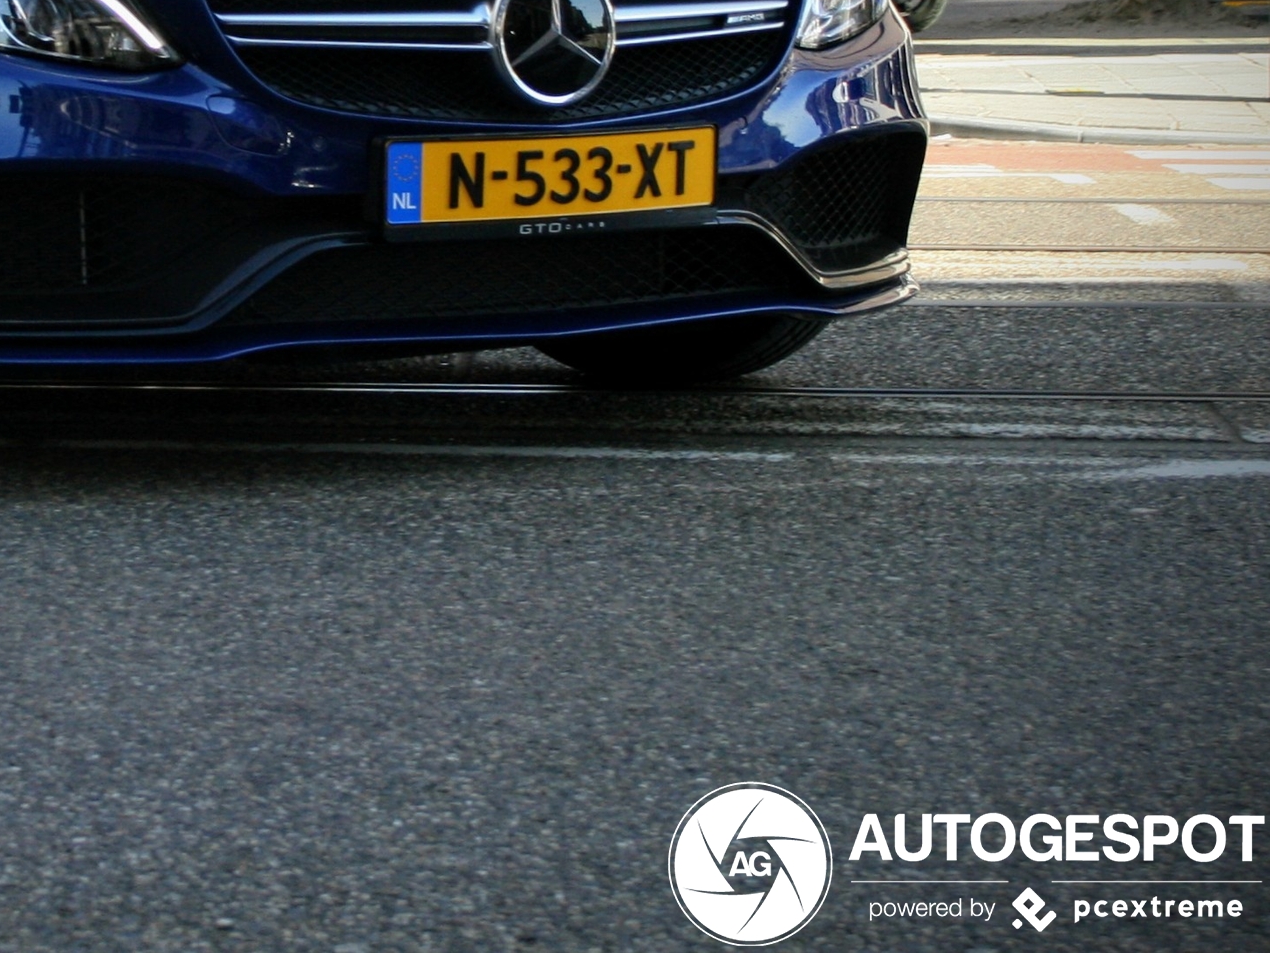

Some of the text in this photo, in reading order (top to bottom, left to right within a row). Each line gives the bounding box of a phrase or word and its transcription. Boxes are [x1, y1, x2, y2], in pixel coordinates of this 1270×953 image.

[448, 139, 696, 210] N-533-XT
[392, 192, 417, 210] NL
[519, 222, 562, 235] GTO
